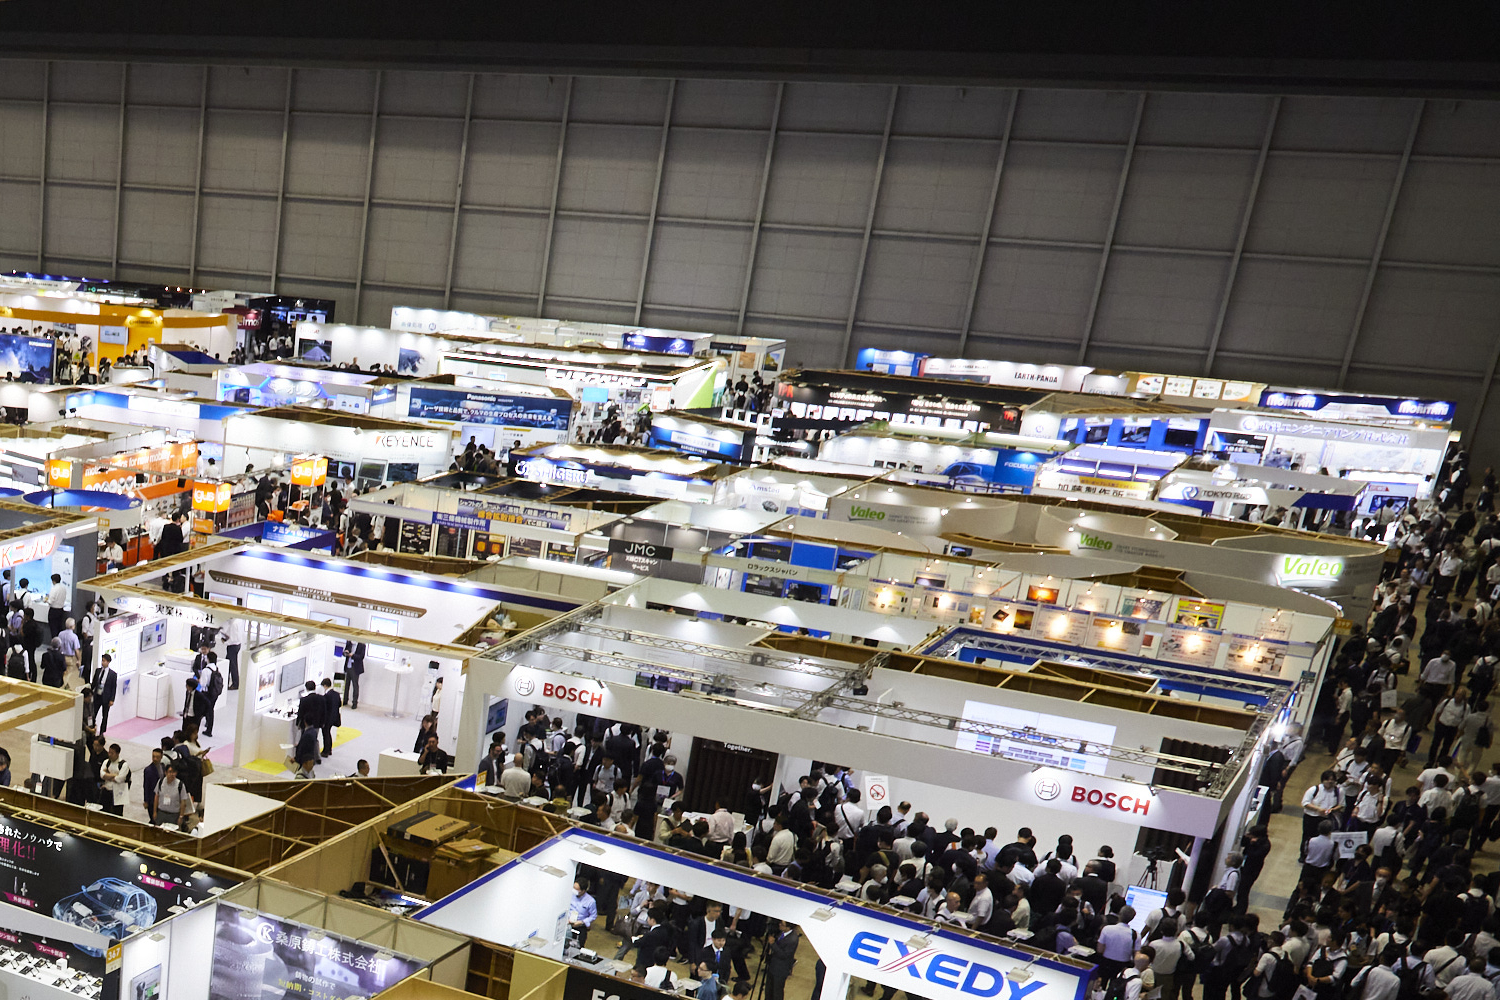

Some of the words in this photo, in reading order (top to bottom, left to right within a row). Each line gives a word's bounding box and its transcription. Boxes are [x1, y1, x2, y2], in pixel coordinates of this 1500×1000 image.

[466, 393, 497, 402] Panasonic
[376, 435, 434, 448] KEYENCE
[182, 443, 196, 460] igus
[51, 465, 70, 480] igus
[293, 464, 313, 479] igus
[314, 463, 327, 480] igus
[194, 487, 215, 503] igus
[217, 488, 231, 505] igus
[1202, 489, 1233, 499] TOKYO
[850, 505, 886, 521] Valeo
[1080, 532, 1113, 551] Valeo
[625, 543, 657, 557] JMC
[631, 563, 650, 572] サービス
[1284, 556, 1343, 577] Valeo
[543, 682, 603, 709] BOSCH
[724, 741, 753, 754] Together.
[1071, 785, 1150, 816] BOSCH
[38, 944, 64, 958] ブレーキ部品
[106, 947, 121, 961] 367
